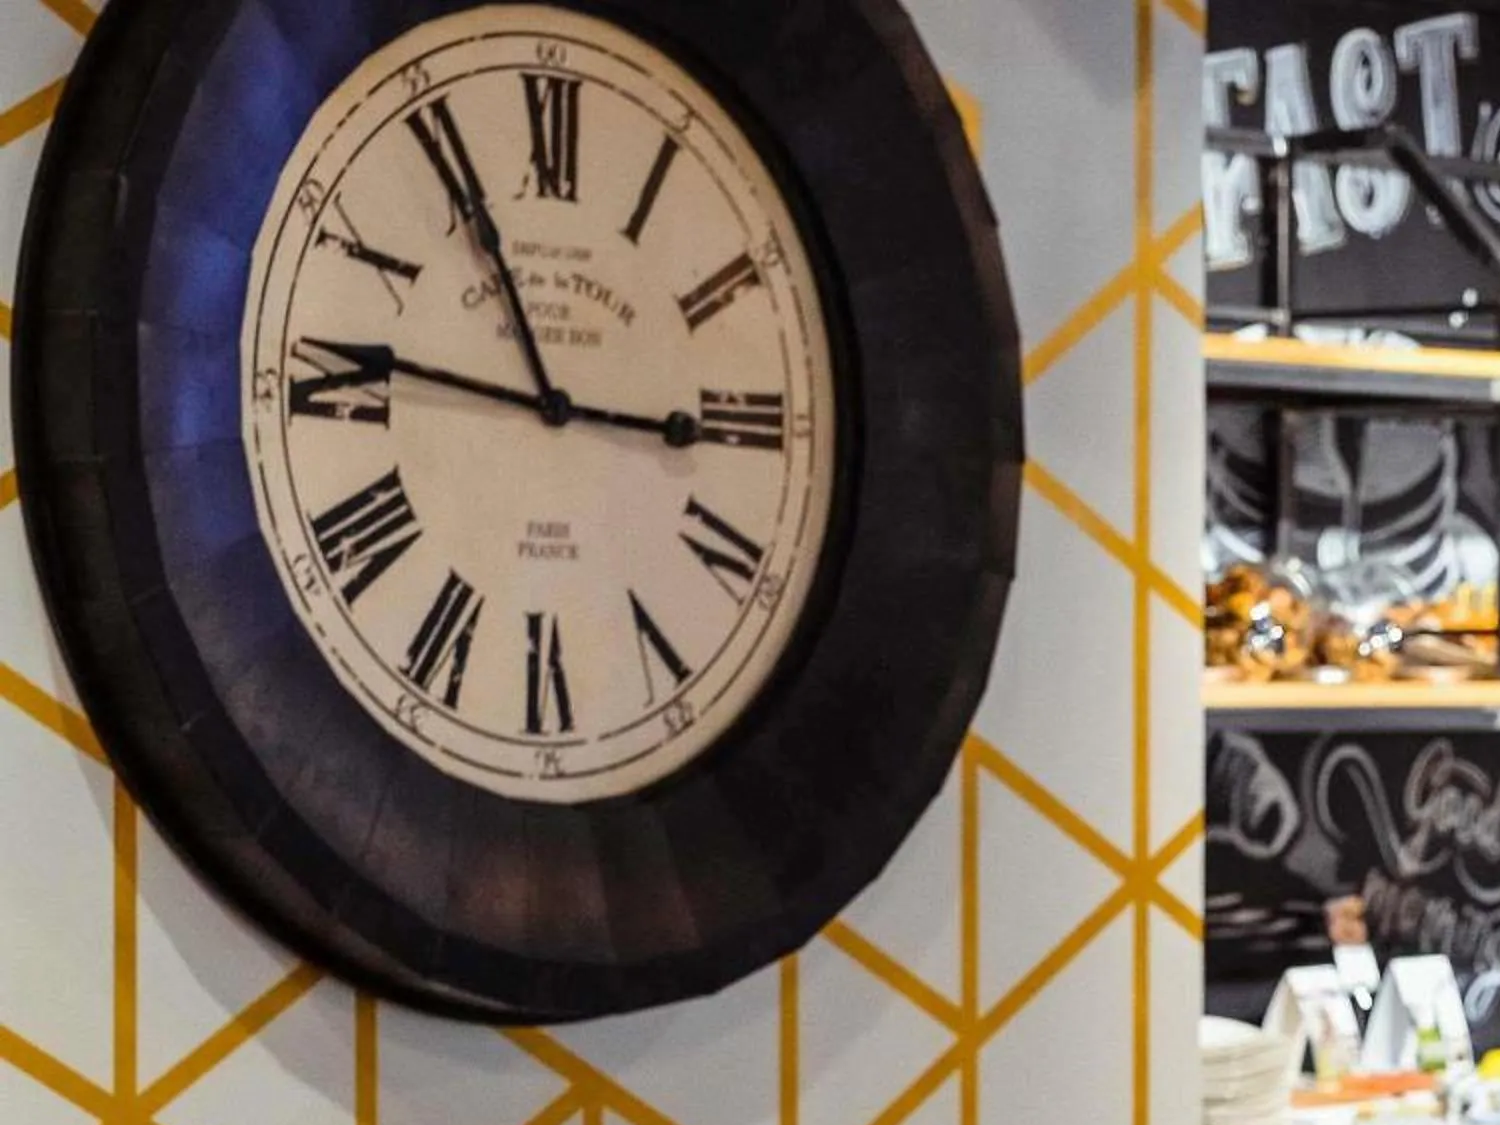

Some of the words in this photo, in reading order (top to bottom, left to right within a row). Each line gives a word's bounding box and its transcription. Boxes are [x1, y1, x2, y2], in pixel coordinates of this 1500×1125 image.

[513, 71, 582, 203] XII
[617, 132, 683, 247] I
[314, 191, 424, 317] X
[461, 266, 526, 311] CAE
[571, 273, 637, 329] TOUR
[674, 252, 762, 335] II
[699, 386, 784, 451] III
[306, 464, 424, 610] VIII
[517, 541, 579, 560] FRANCE
[527, 520, 570, 539] PARIS
[678, 493, 764, 608] IV
[398, 565, 486, 711] VII
[519, 611, 574, 735] VI
[627, 588, 694, 708] V
